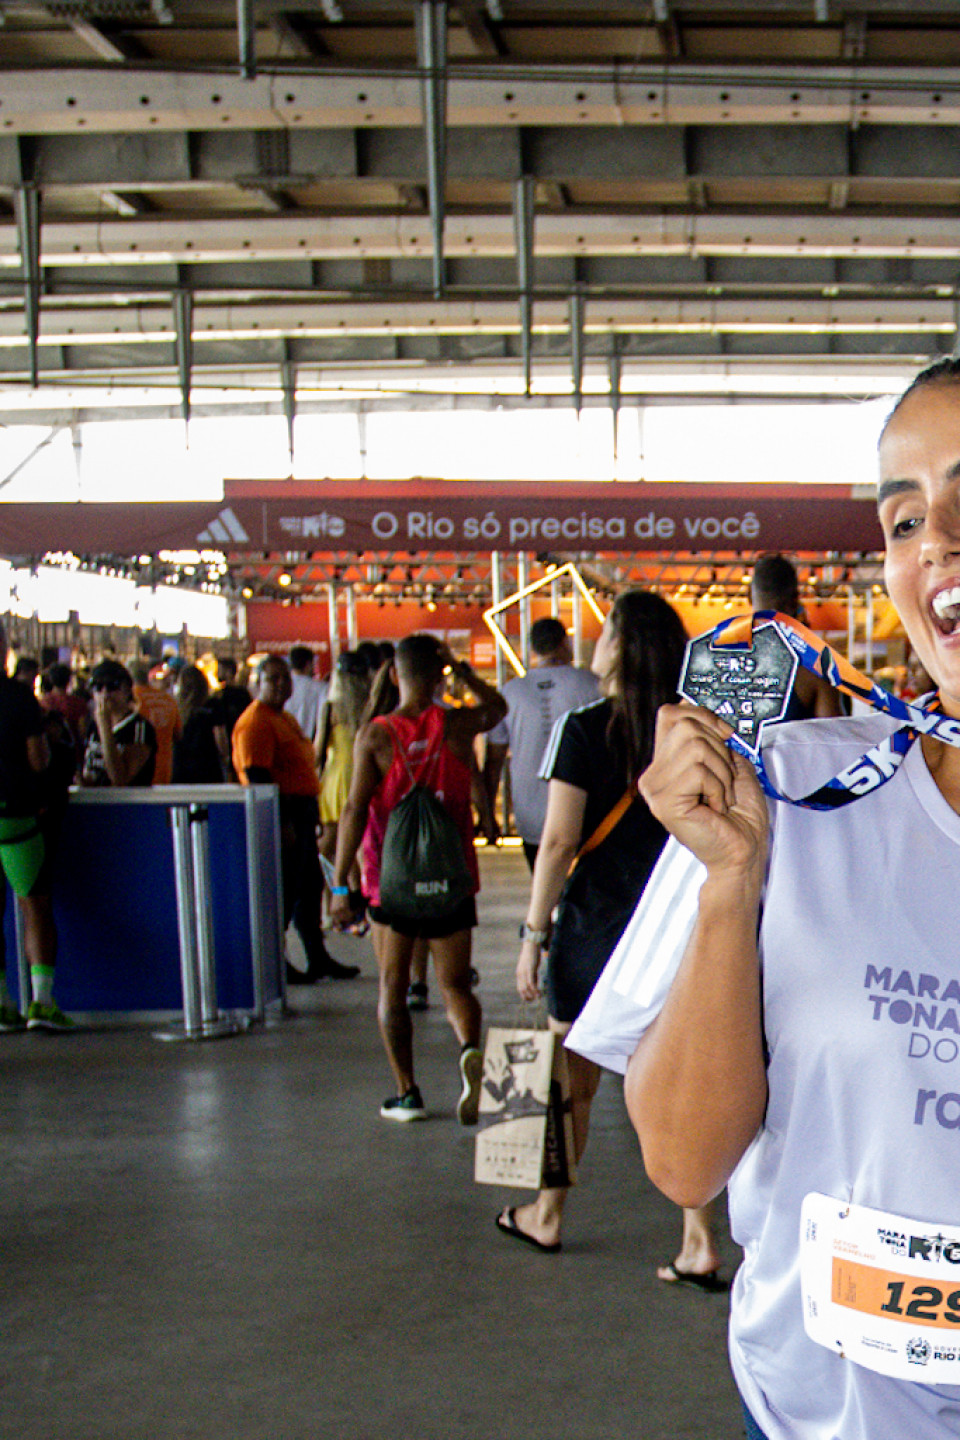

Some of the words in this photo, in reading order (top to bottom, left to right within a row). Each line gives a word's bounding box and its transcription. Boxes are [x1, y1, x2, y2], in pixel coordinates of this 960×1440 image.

[371, 511, 398, 538] O
[407, 511, 454, 538] Rio
[463, 510, 500, 538] só
[509, 512, 625, 544] precisa
[634, 512, 675, 538] de
[684, 511, 760, 538] você
[836, 736, 903, 796] 5K
[415, 880, 449, 896] RUN
[907, 1032, 960, 1064] DO
[934, 1352, 955, 1361] RIO
